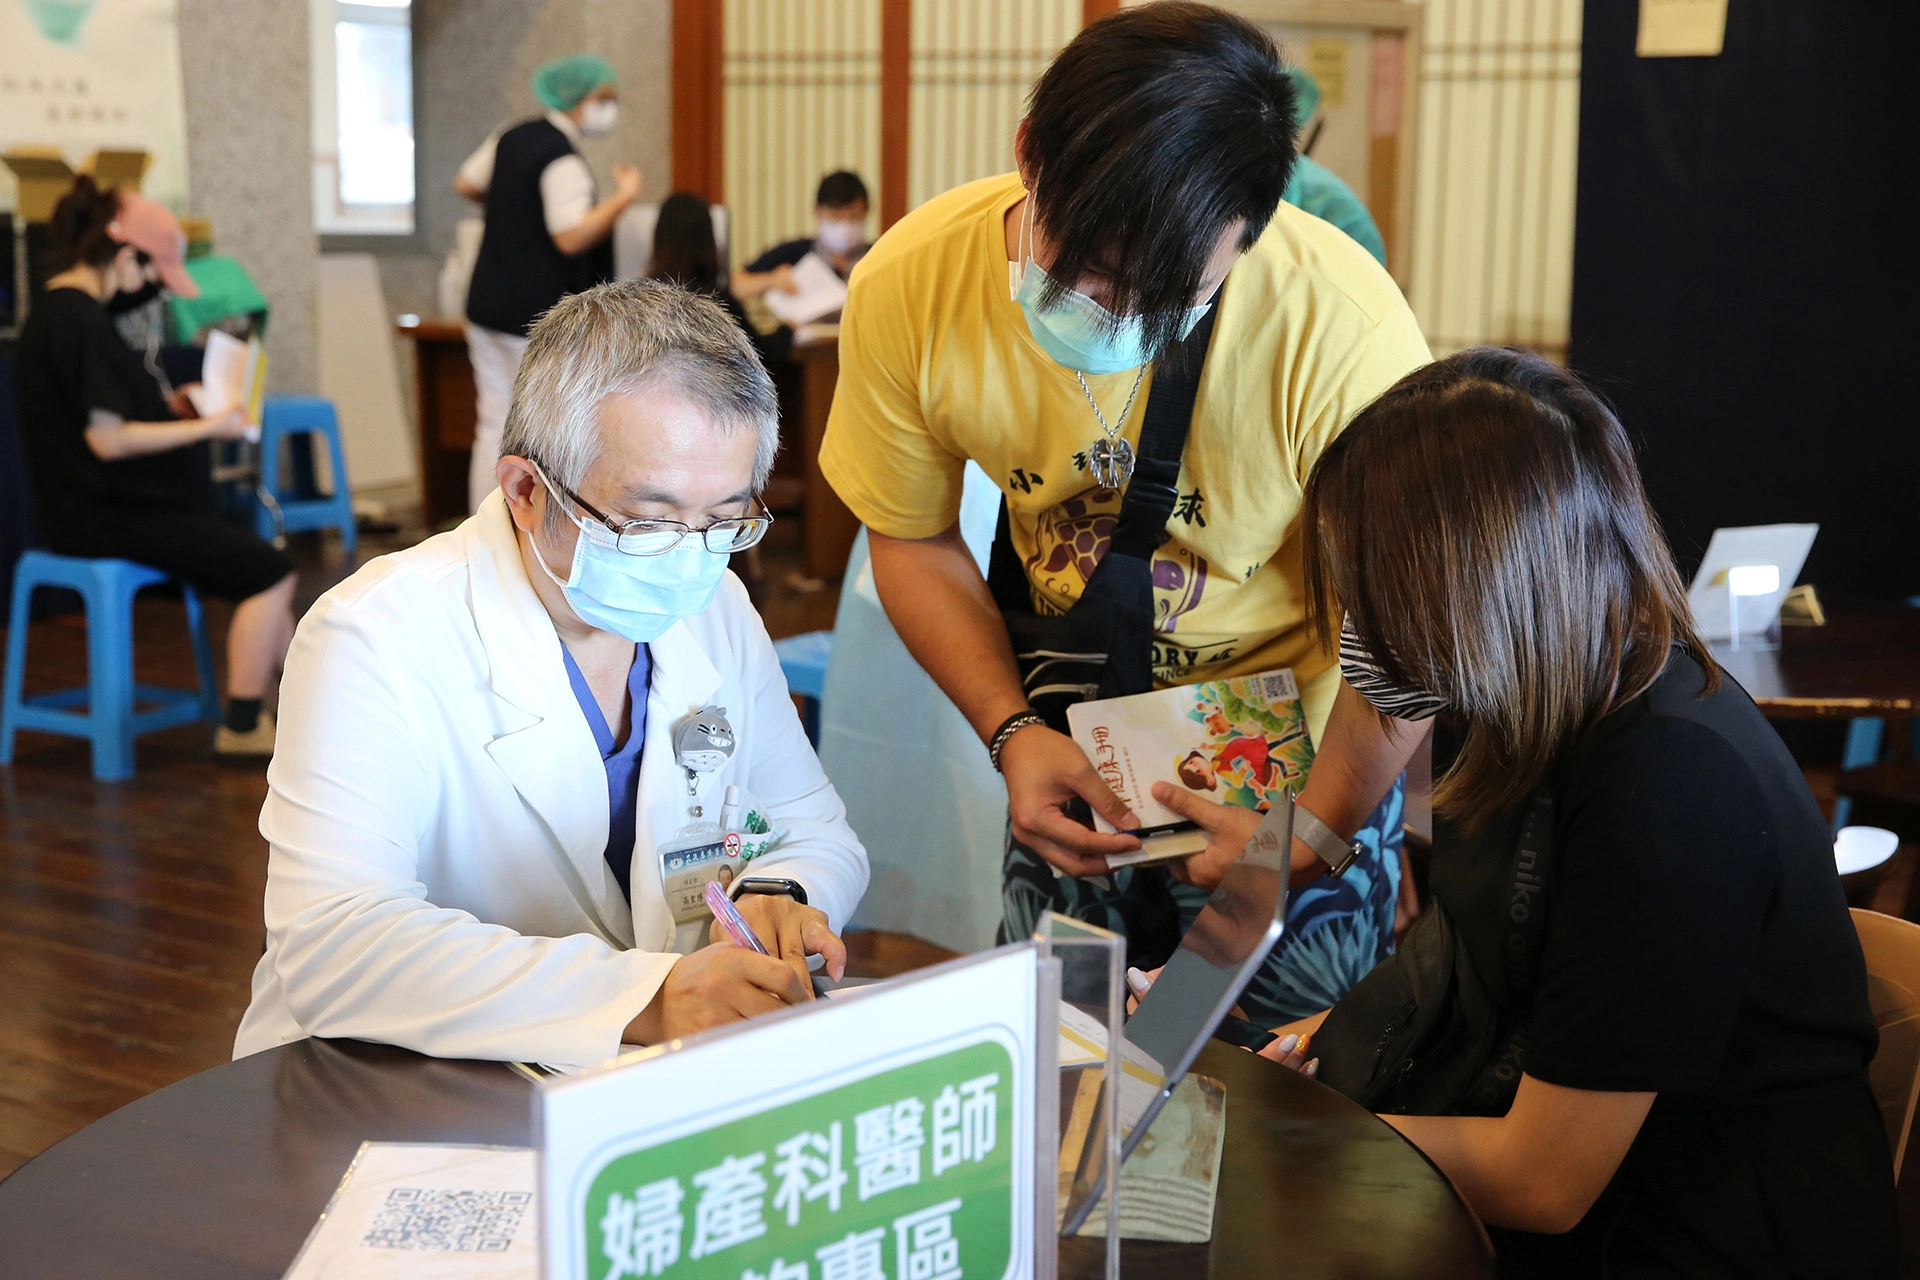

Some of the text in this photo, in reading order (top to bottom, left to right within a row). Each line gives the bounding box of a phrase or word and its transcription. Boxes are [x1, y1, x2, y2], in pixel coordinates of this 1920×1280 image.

[1509, 849, 1542, 924] niko
[600, 1073, 999, 1280] 婦產科醫師
